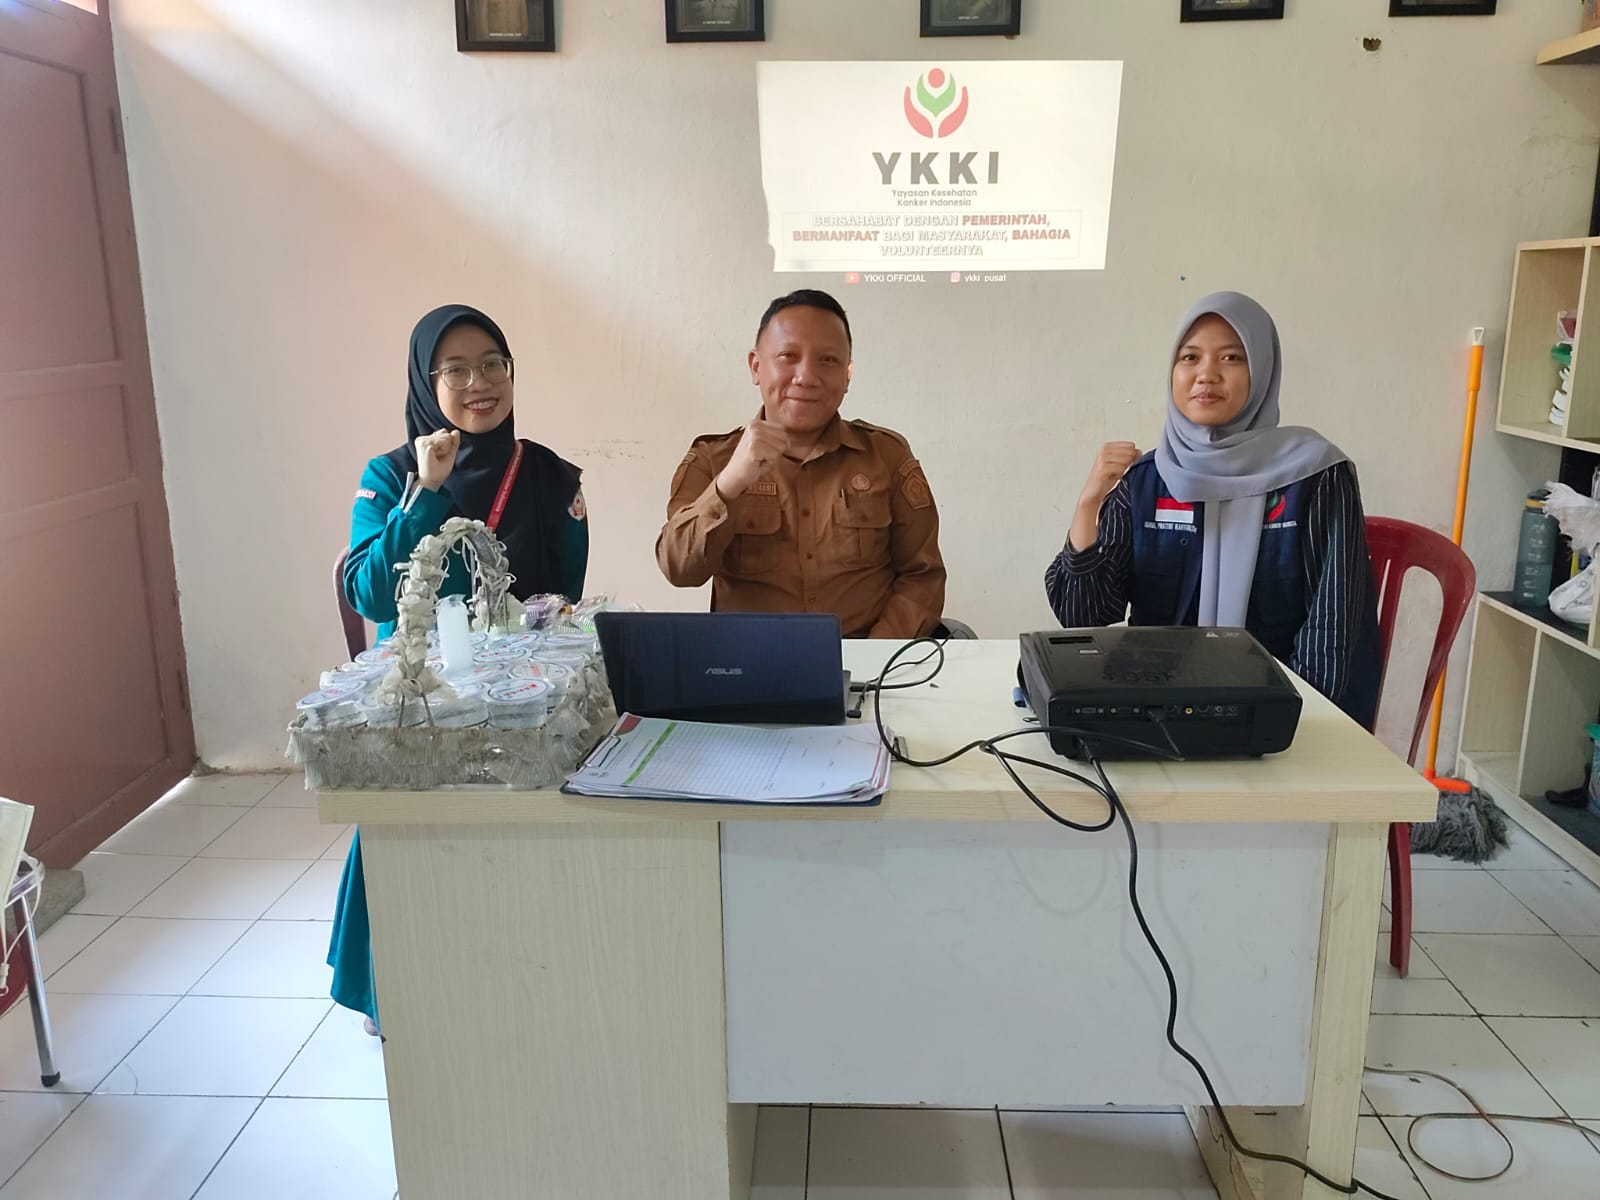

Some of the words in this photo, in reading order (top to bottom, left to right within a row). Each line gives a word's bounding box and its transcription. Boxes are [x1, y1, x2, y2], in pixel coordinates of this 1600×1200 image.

[872, 151, 999, 185] YKKI
[891, 189, 929, 198] Yayasan
[931, 188, 977, 197] Kesehatan
[897, 199, 928, 207] Kanker
[930, 198, 972, 207] Indonesia
[813, 214, 901, 227] BERSAHABAT
[904, 214, 959, 227] DENGAN
[962, 214, 1050, 227] PEMERINTAH,
[792, 230, 880, 242] BERMANFAAT
[883, 230, 914, 242] BAGI
[917, 229, 1008, 242] MASYARAKAT,
[1012, 229, 1071, 241] BAHAGIA
[879, 244, 984, 257] VOLUNTEERNYA
[864, 274, 884, 283] YKKI
[886, 274, 926, 283] OFFICIAL
[705, 667, 743, 675] ASUS
